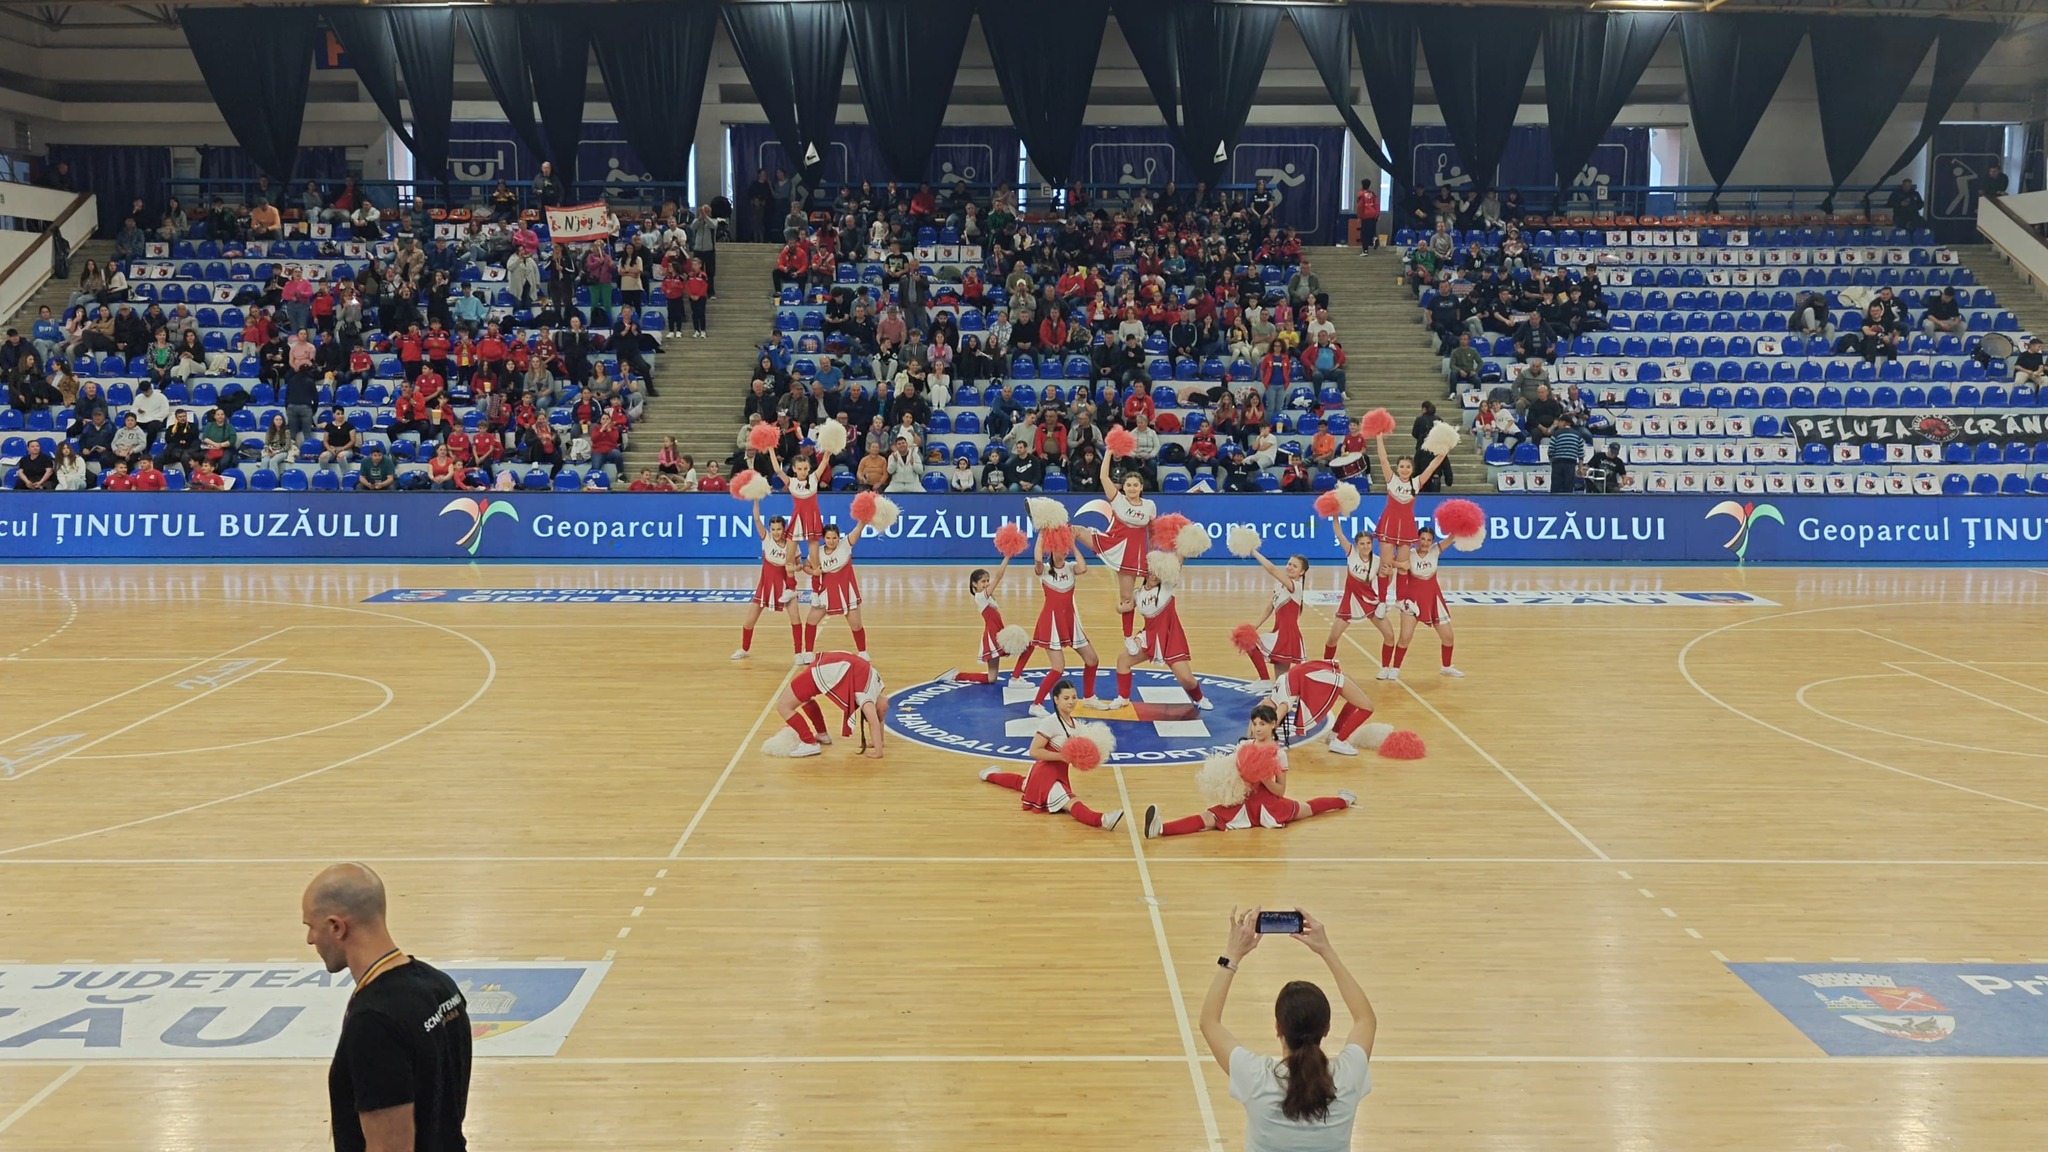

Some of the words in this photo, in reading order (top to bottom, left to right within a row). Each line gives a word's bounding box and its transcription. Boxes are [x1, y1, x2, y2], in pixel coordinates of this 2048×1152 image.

[1796, 417, 1912, 440] PELUZA
[1963, 413, 2048, 437] CRÂN
[219, 508, 398, 537] BUZĂULUI
[532, 514, 683, 544] Geoparcul
[1490, 511, 1665, 540] BUZĂULUI
[1798, 517, 1949, 547] Geoparcul
[457, 594, 598, 602] Gloria
[1111, 748, 1208, 761] PORT
[31, 969, 357, 994] JUDEȚEA
